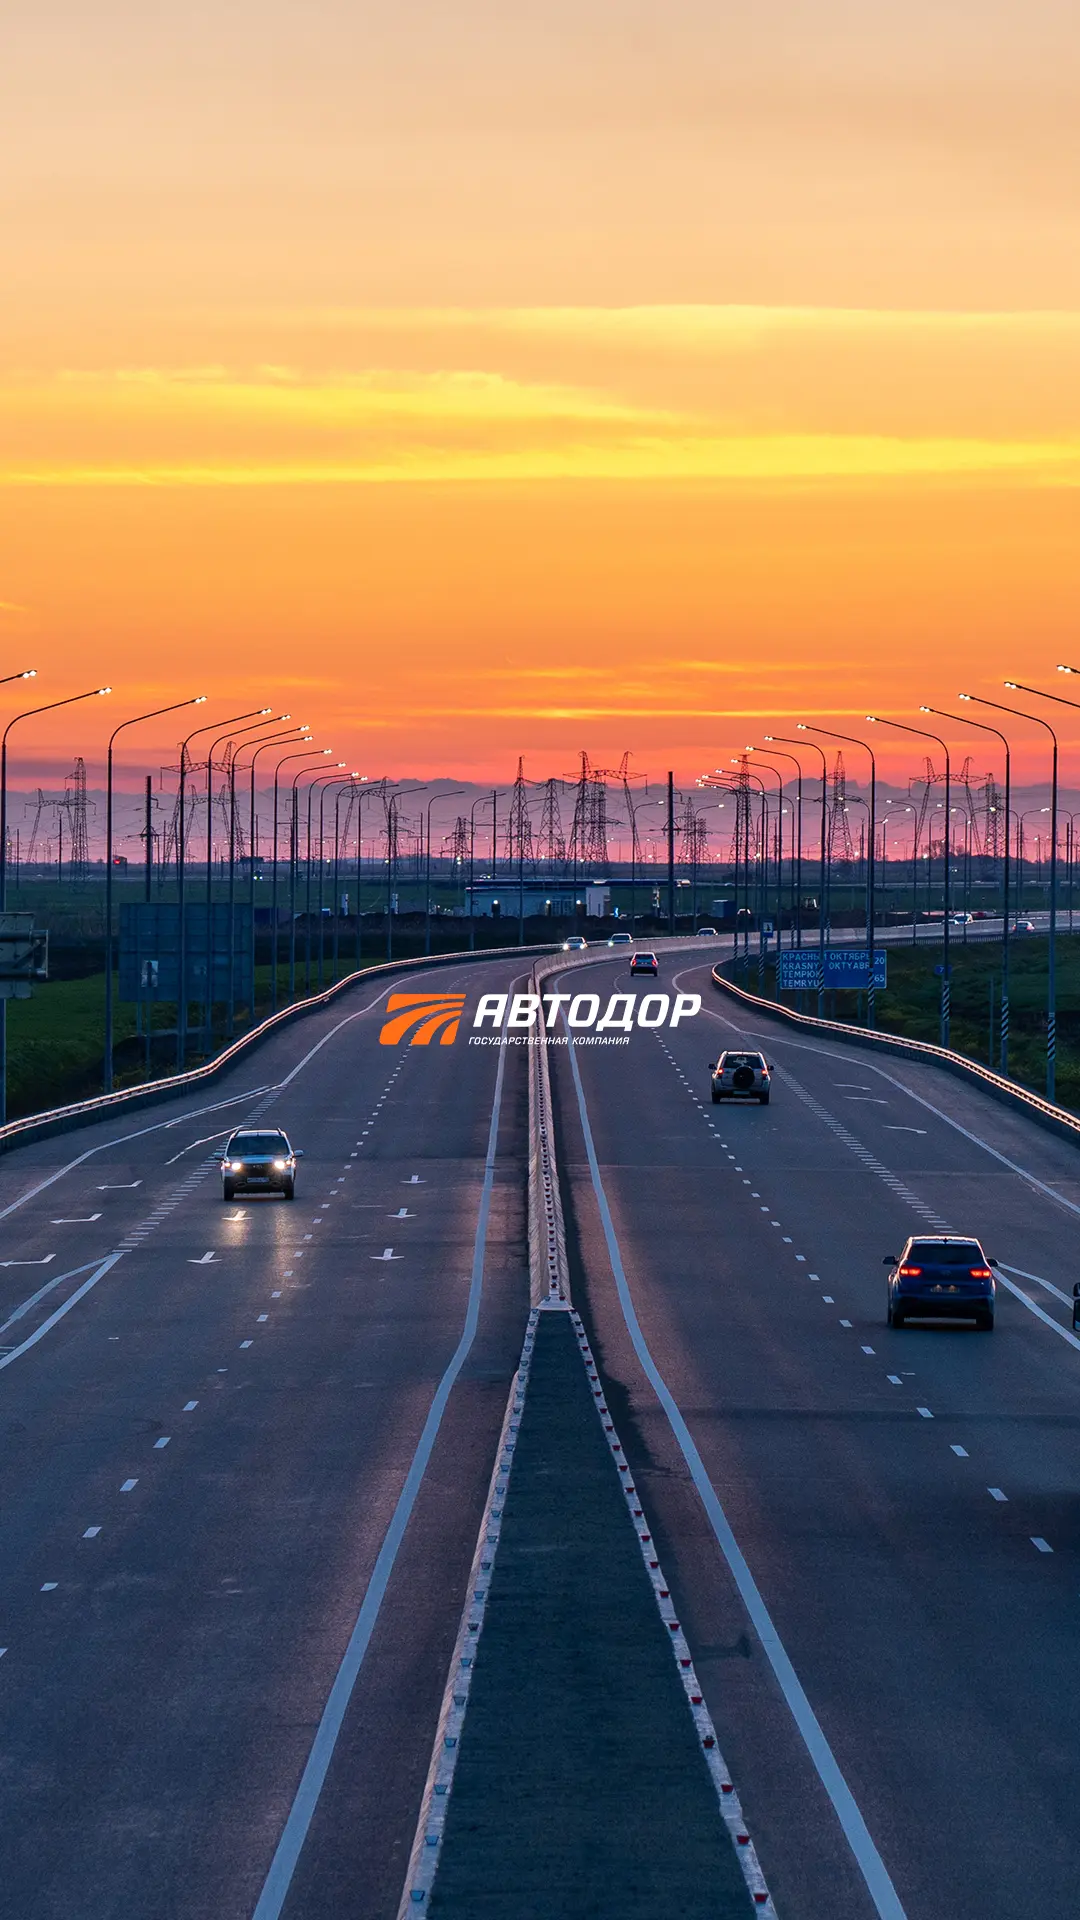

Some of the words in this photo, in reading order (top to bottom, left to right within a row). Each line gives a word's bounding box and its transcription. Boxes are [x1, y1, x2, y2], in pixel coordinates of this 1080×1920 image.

[874, 957, 885, 965] 20
[874, 974, 885, 982] 65
[783, 979, 821, 987] TEMRYU
